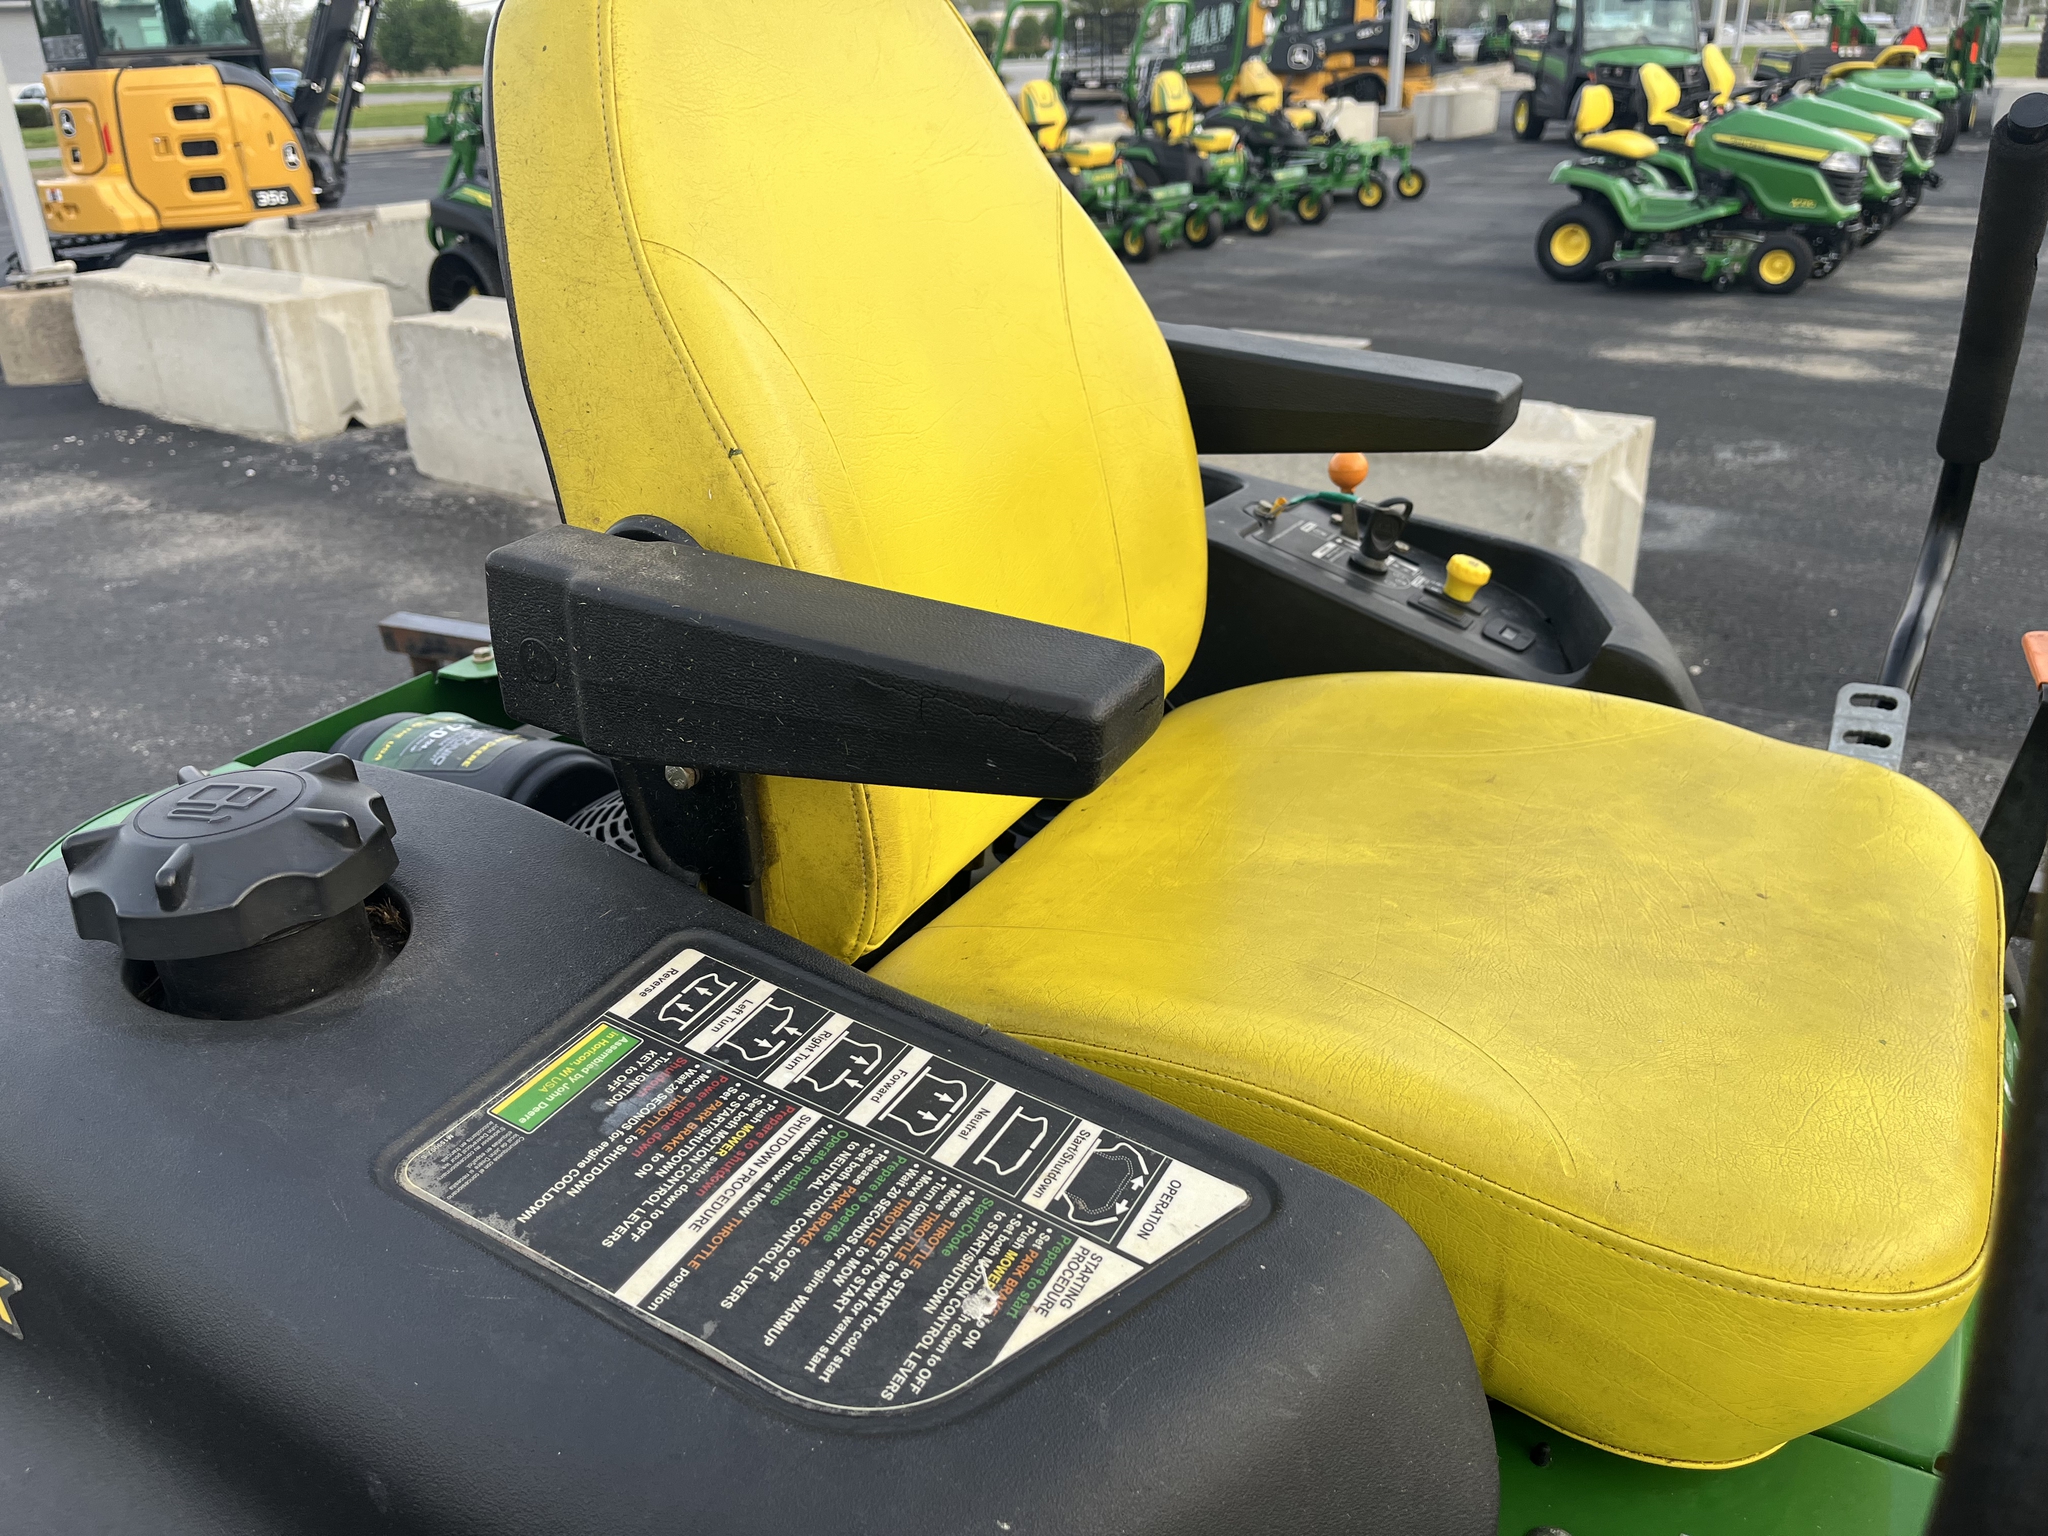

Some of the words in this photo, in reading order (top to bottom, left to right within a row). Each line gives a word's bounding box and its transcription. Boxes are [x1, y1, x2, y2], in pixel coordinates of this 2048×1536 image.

[429, 723, 470, 739] 7.0
[639, 967, 678, 996] Reverse
[731, 999, 753, 1014] Left
[711, 1016, 736, 1032] Turn
[570, 1039, 608, 1064] Horicon,
[805, 1030, 832, 1051] Right
[581, 1036, 627, 1073] Assembled
[636, 1050, 657, 1066] KEY
[645, 1056, 669, 1071] Turn
[785, 1053, 810, 1069] Turn
[538, 1076, 561, 1091] USA
[559, 1067, 574, 1076] WI
[568, 1073, 583, 1082] by
[607, 1075, 626, 1091] OFF
[635, 1057, 688, 1098] Shutdown
[674, 1068, 696, 1083] Wait
[683, 1073, 708, 1092] Move
[545, 1082, 569, 1100] John
[604, 1072, 649, 1106] IGNITION
[664, 1083, 678, 1093] 20
[695, 1075, 728, 1101] Power
[719, 1087, 737, 1099] Set
[737, 1092, 749, 1100] to
[870, 1069, 907, 1103] Forward
[518, 1101, 548, 1123] Deere
[621, 1093, 667, 1130] SECONDS
[635, 1095, 686, 1135] THROTTLE
[661, 1102, 695, 1130] engine
[694, 1100, 722, 1122] PARK
[744, 1098, 762, 1111] Set
[750, 1103, 775, 1122] Push
[725, 1111, 748, 1128] both
[755, 1105, 795, 1137] Prepare
[957, 1107, 990, 1139] Neutral
[608, 1129, 624, 1141] for
[624, 1135, 637, 1143] to
[631, 1131, 661, 1157] down
[655, 1101, 740, 1177] START/SHUTDOWN
[661, 1122, 697, 1152] BRAKE
[689, 1129, 728, 1163] MOTION
[715, 1123, 753, 1156] MOWER
[744, 1139, 758, 1148] to
[753, 1114, 811, 1167] SHUTDOWN
[792, 1127, 827, 1161] ALWAYS
[810, 1130, 848, 1164] Operate
[847, 1141, 859, 1149] to
[473, 1157, 489, 1169] Deere
[488, 1147, 501, 1157] John
[577, 1141, 608, 1167] engine
[651, 1153, 664, 1162] to
[855, 1147, 872, 1161] Set
[1032, 1129, 1090, 1197] Start/Shutdown
[566, 1144, 626, 1196] SHUTDOWN
[634, 1163, 653, 1178] ON
[686, 1156, 717, 1183] switch
[695, 1150, 745, 1196] shutdown
[771, 1161, 793, 1182] mow
[807, 1150, 851, 1189] NEUTRAL
[837, 1161, 860, 1180] both
[852, 1153, 886, 1184] Release
[869, 1155, 906, 1190] Prepare
[896, 1168, 918, 1186] Wait
[516, 1169, 579, 1222] COOLDOWN
[641, 1164, 691, 1205] CONTROL
[660, 1184, 687, 1208] down
[761, 1182, 772, 1192] at
[770, 1165, 811, 1205] machine
[858, 1192, 872, 1201] to
[886, 1186, 900, 1198] 20
[907, 1174, 931, 1196] Move
[923, 1182, 946, 1200] Turn
[688, 1167, 757, 1232] PROCEDURE
[738, 1191, 765, 1217] MOW
[803, 1181, 841, 1217] MOTION
[828, 1186, 855, 1211] PARK
[935, 1187, 959, 1210] Move
[949, 1194, 973, 1217] Move
[1136, 1179, 1181, 1239] OPERATION
[650, 1209, 663, 1218] to
[823, 1203, 859, 1241] operate
[846, 1198, 890, 1244] SECONDS
[864, 1198, 911, 1246] THROTTLE
[888, 1200, 928, 1242] IGNITION
[941, 1197, 993, 1255] Start/Choke
[993, 1211, 1006, 1220] to
[1003, 1218, 1020, 1234] Set
[602, 1207, 645, 1247] LEVERS
[631, 1220, 652, 1241] OFF
[797, 1211, 832, 1245] BRAKE
[894, 1212, 939, 1260] THROTTLE
[1016, 1225, 1035, 1243] Push
[687, 1218, 742, 1269] THROTTLE
[758, 1218, 806, 1263] CONTROL
[787, 1246, 800, 1257] to
[833, 1244, 850, 1259] for
[855, 1246, 869, 1256] to
[872, 1242, 893, 1265] KEY
[909, 1219, 954, 1268] THROTTLE
[986, 1234, 1009, 1255] both
[1032, 1232, 1049, 1249] Set
[885, 1260, 898, 1270] to
[923, 1222, 998, 1313] START/SHUTDOWN
[1012, 1249, 1038, 1277] PARK
[1036, 1235, 1071, 1275] Prepare
[769, 1259, 789, 1281] OFF
[804, 1259, 835, 1293] engine
[832, 1257, 860, 1286] MOW
[861, 1264, 874, 1274] to
[900, 1268, 913, 1278] to
[954, 1256, 992, 1298] MOTION
[1034, 1245, 1090, 1317] PROCEDURE
[1059, 1253, 1102, 1308] STARTING
[647, 1267, 689, 1310] position
[720, 1266, 763, 1308] LEVERS
[833, 1276, 865, 1312] START
[863, 1271, 890, 1300] MOW
[1027, 1277, 1041, 1289] to
[850, 1299, 867, 1315] for
[873, 1279, 904, 1315] START
[957, 1286, 991, 1324] sch
[1006, 1290, 1029, 1318] start
[764, 1295, 808, 1345] WARMUP
[825, 1316, 853, 1344] warm
[860, 1314, 877, 1331] for
[914, 1297, 962, 1352] CONTROL
[840, 1331, 861, 1356] cold
[936, 1323, 961, 1352] down
[962, 1329, 980, 1348] ON
[804, 1345, 828, 1372] start
[818, 1355, 842, 1382] start
[927, 1354, 941, 1366] to
[879, 1351, 922, 1401] LEVERS
[910, 1368, 931, 1394] OFF
